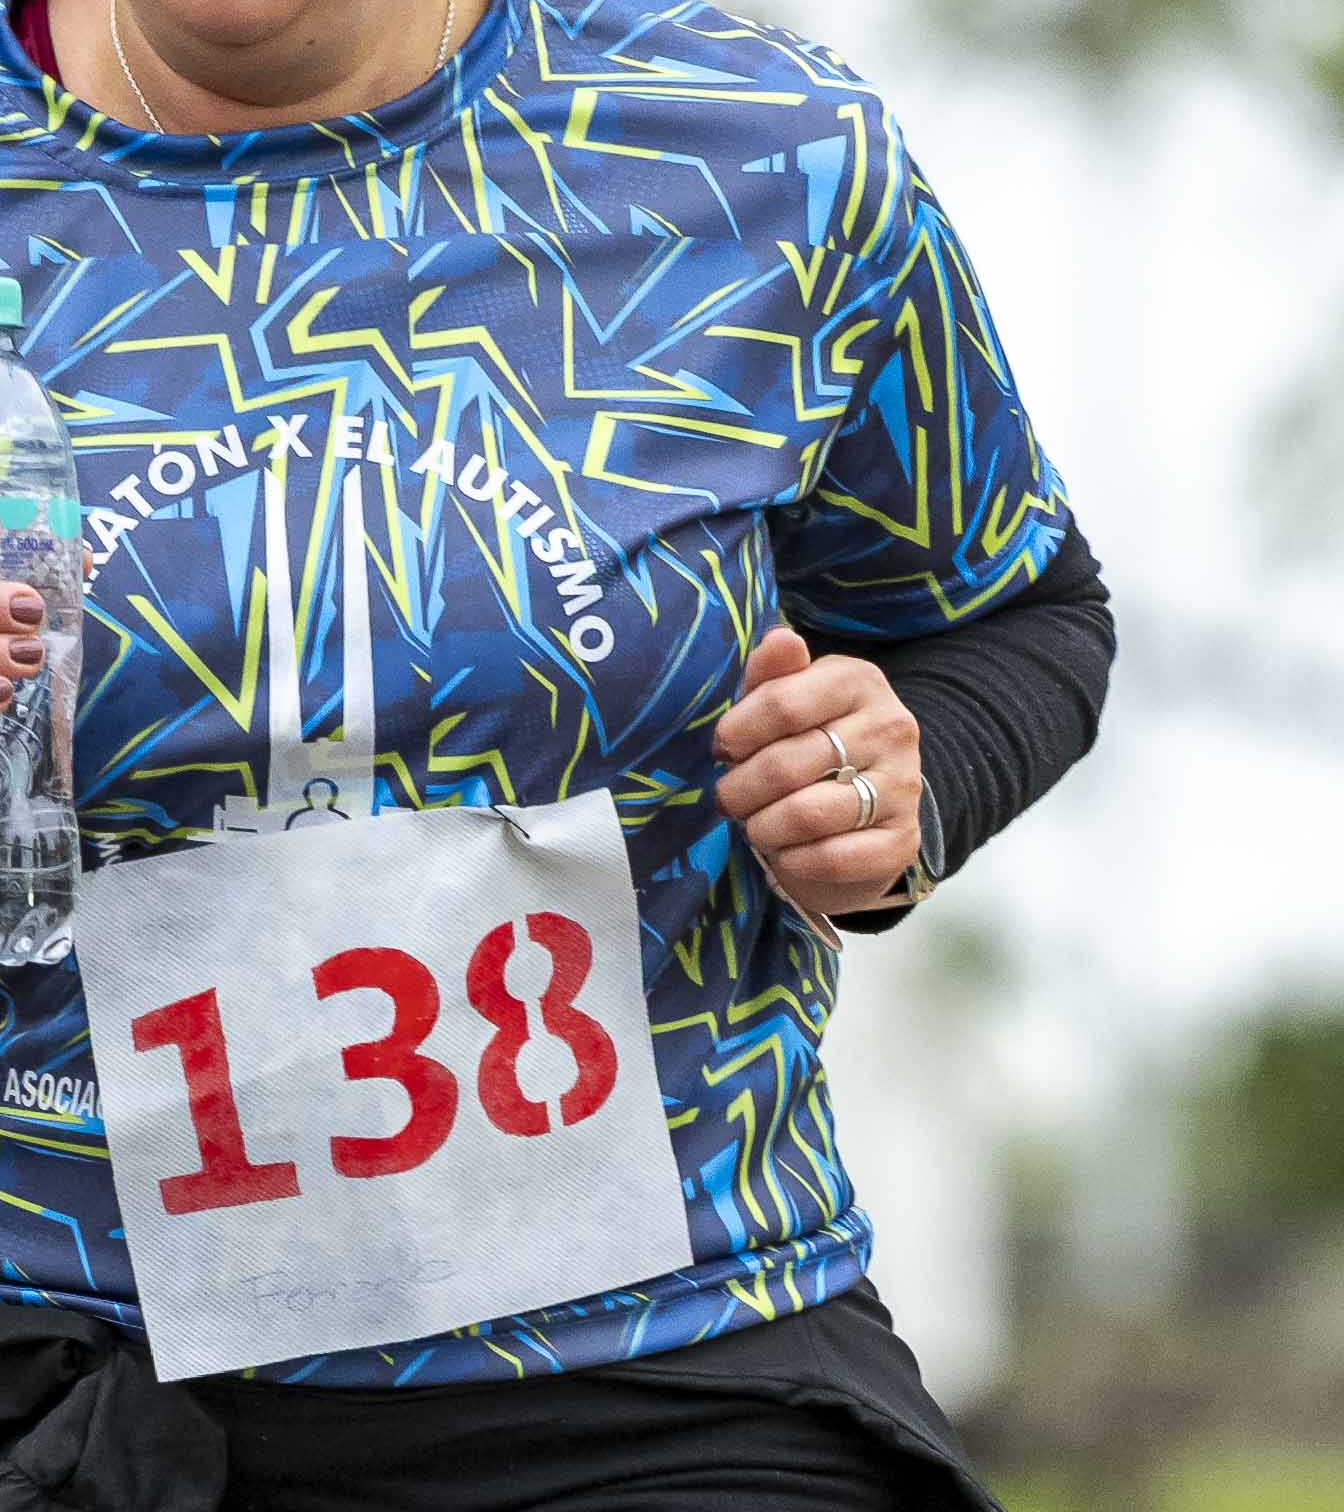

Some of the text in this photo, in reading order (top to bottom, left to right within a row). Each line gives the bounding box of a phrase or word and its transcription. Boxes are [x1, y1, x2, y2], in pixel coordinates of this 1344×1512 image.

[266, 414, 313, 458] X
[334, 415, 394, 466] EL
[409, 439, 615, 663] AUTISMO
[131, 911, 619, 1216] 138
